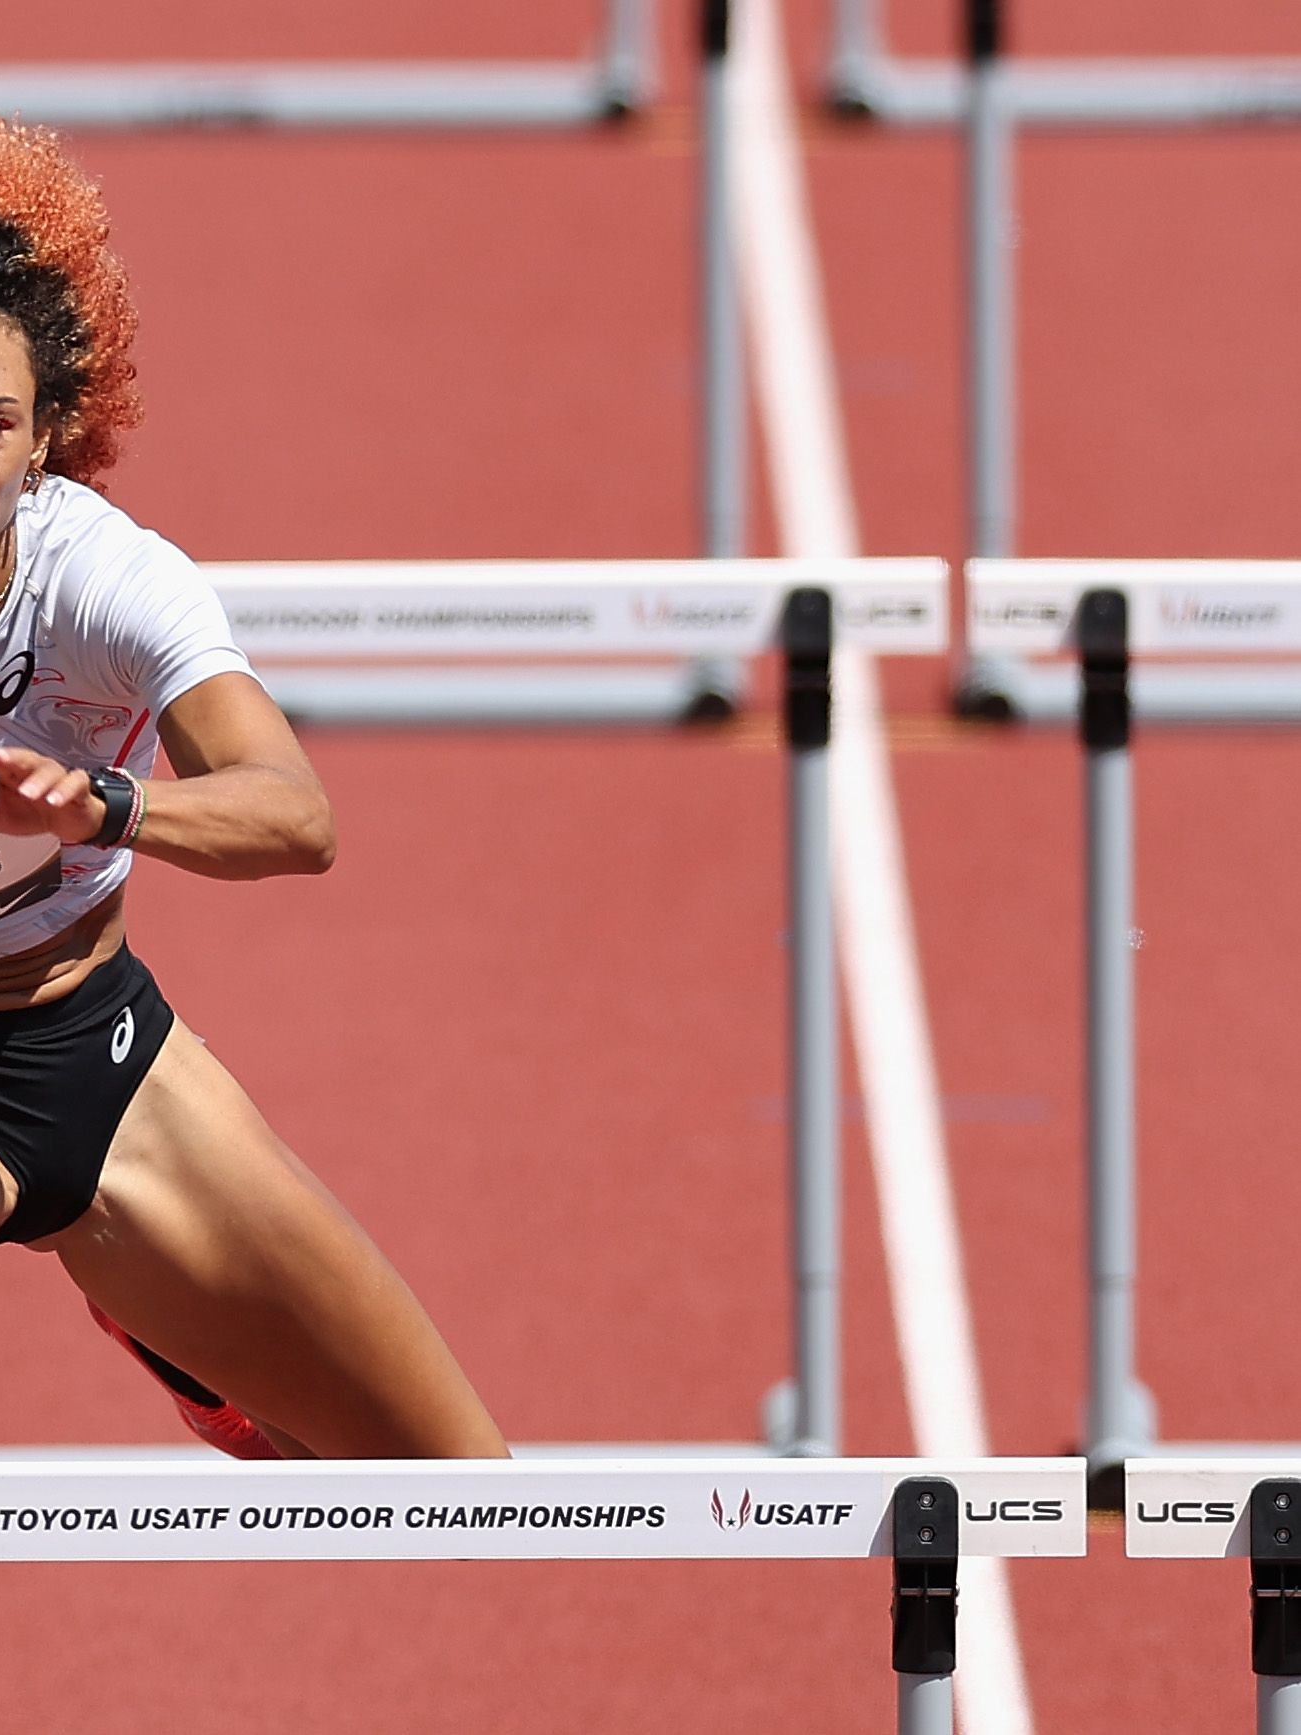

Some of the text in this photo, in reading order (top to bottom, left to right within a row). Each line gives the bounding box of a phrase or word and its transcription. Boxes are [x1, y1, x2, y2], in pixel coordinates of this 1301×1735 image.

[0, 1508, 118, 1531] TOYOTA
[130, 1507, 230, 1530] USATF
[239, 1506, 394, 1529] OUTDOOR
[405, 1505, 665, 1529] CHAMPIONSHIPS
[753, 1503, 854, 1526] USATF
[966, 1500, 1063, 1522] UCS
[1137, 1502, 1236, 1523] UCS
